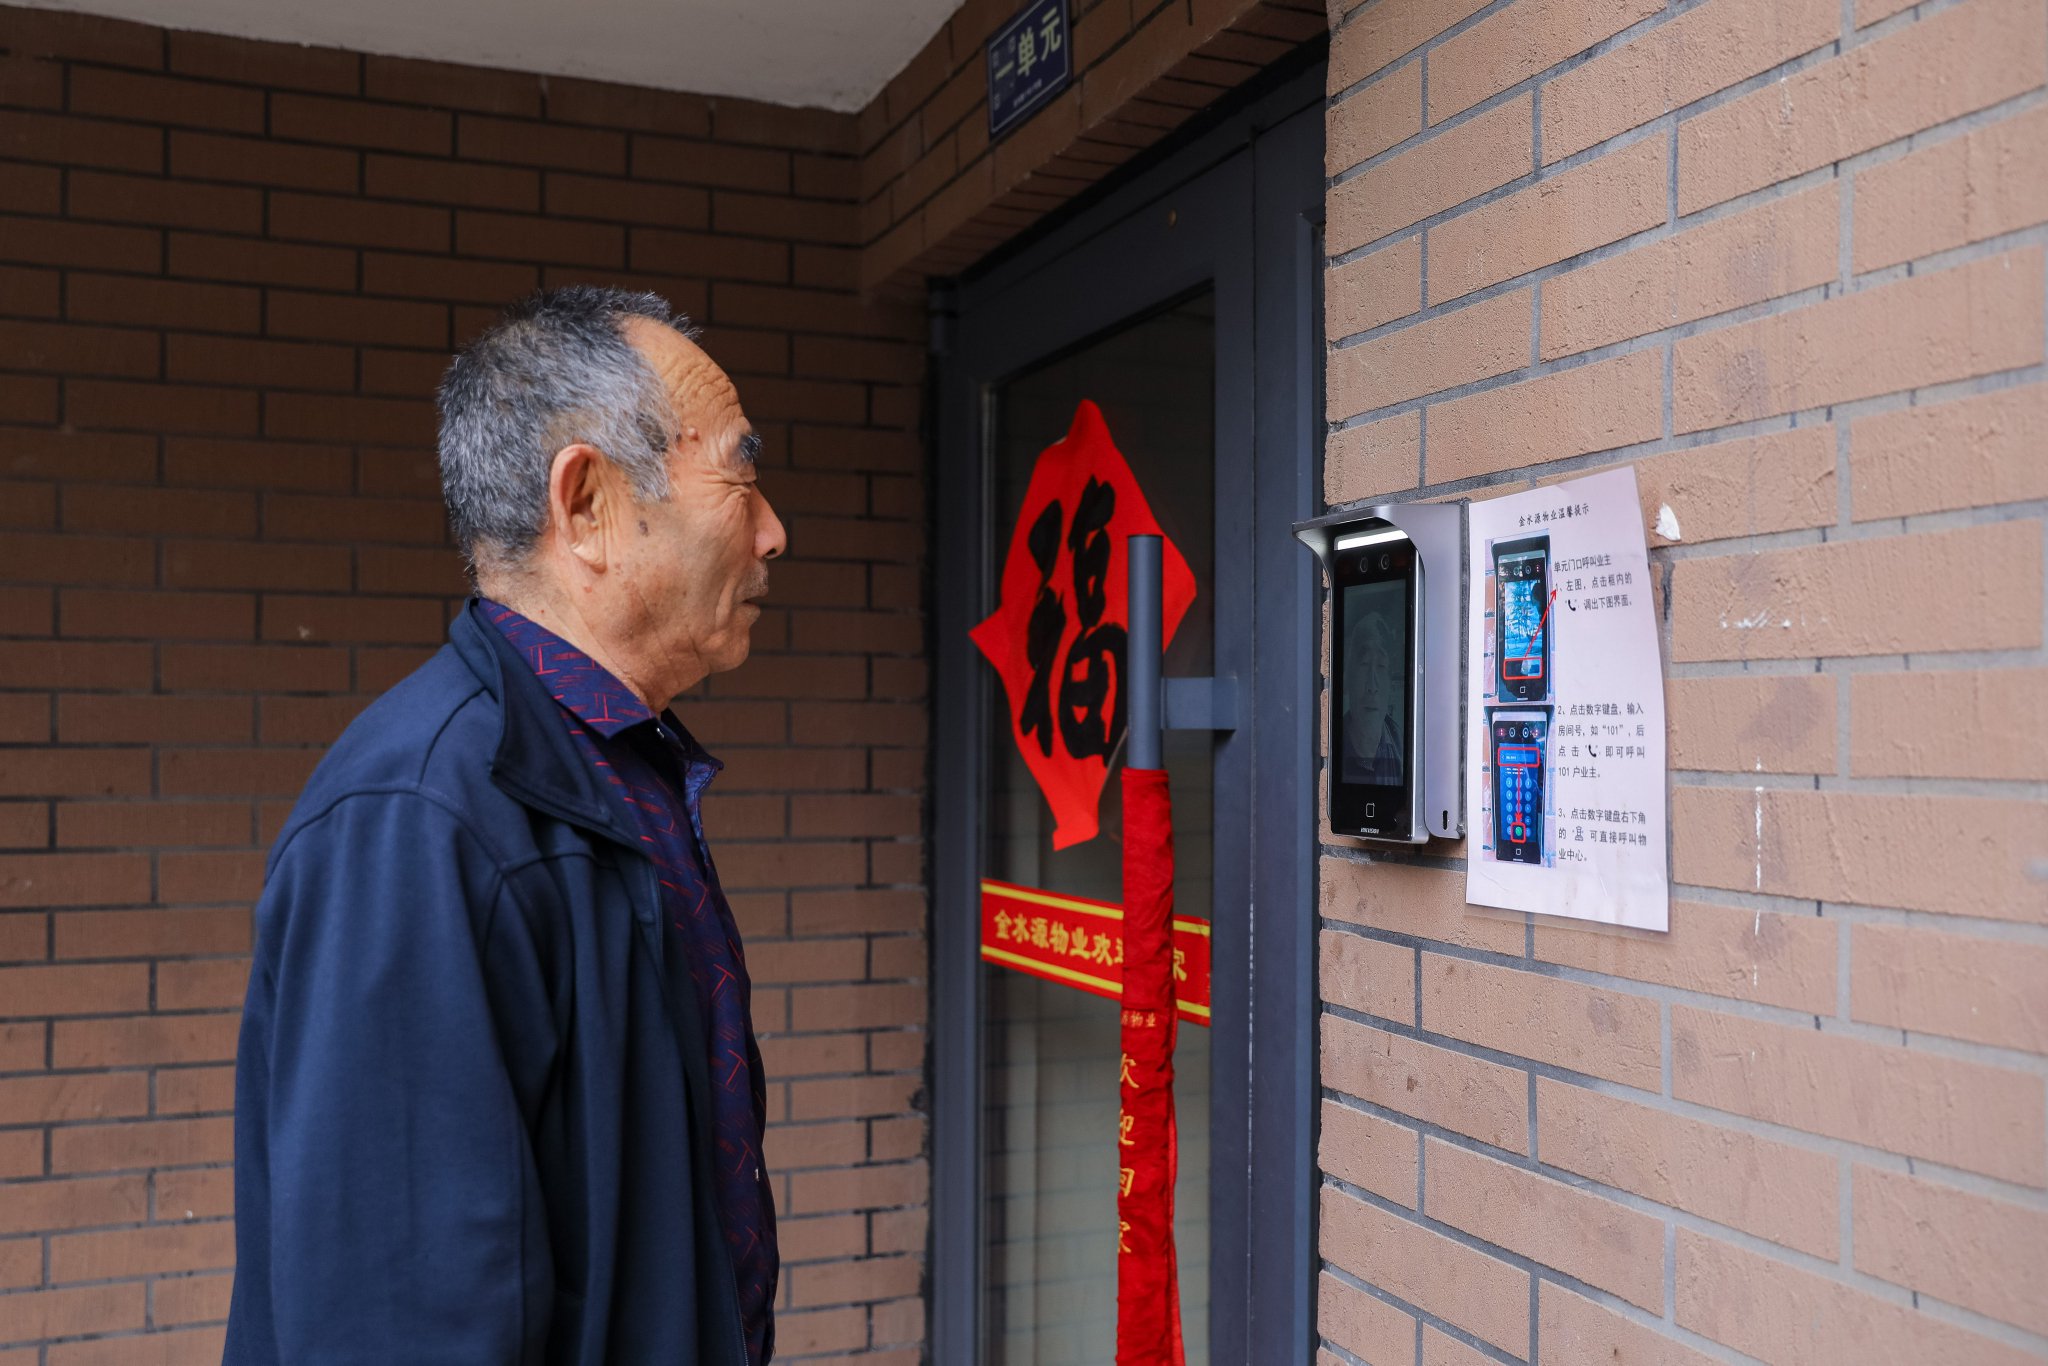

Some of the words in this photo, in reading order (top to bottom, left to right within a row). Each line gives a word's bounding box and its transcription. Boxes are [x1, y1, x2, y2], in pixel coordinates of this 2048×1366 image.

[994, 6, 1062, 81] 一单元
[1518, 503, 1590, 527] 金水源物业温馨提示
[1554, 554, 1612, 573] 单元门口呼叫业主
[1019, 474, 1128, 767] 福
[1557, 702, 1644, 716] 2、点击数字键盘，输入
[1558, 808, 1646, 825] 3、点击数字键盘右下角
[1558, 848, 1588, 862] 业中心。
